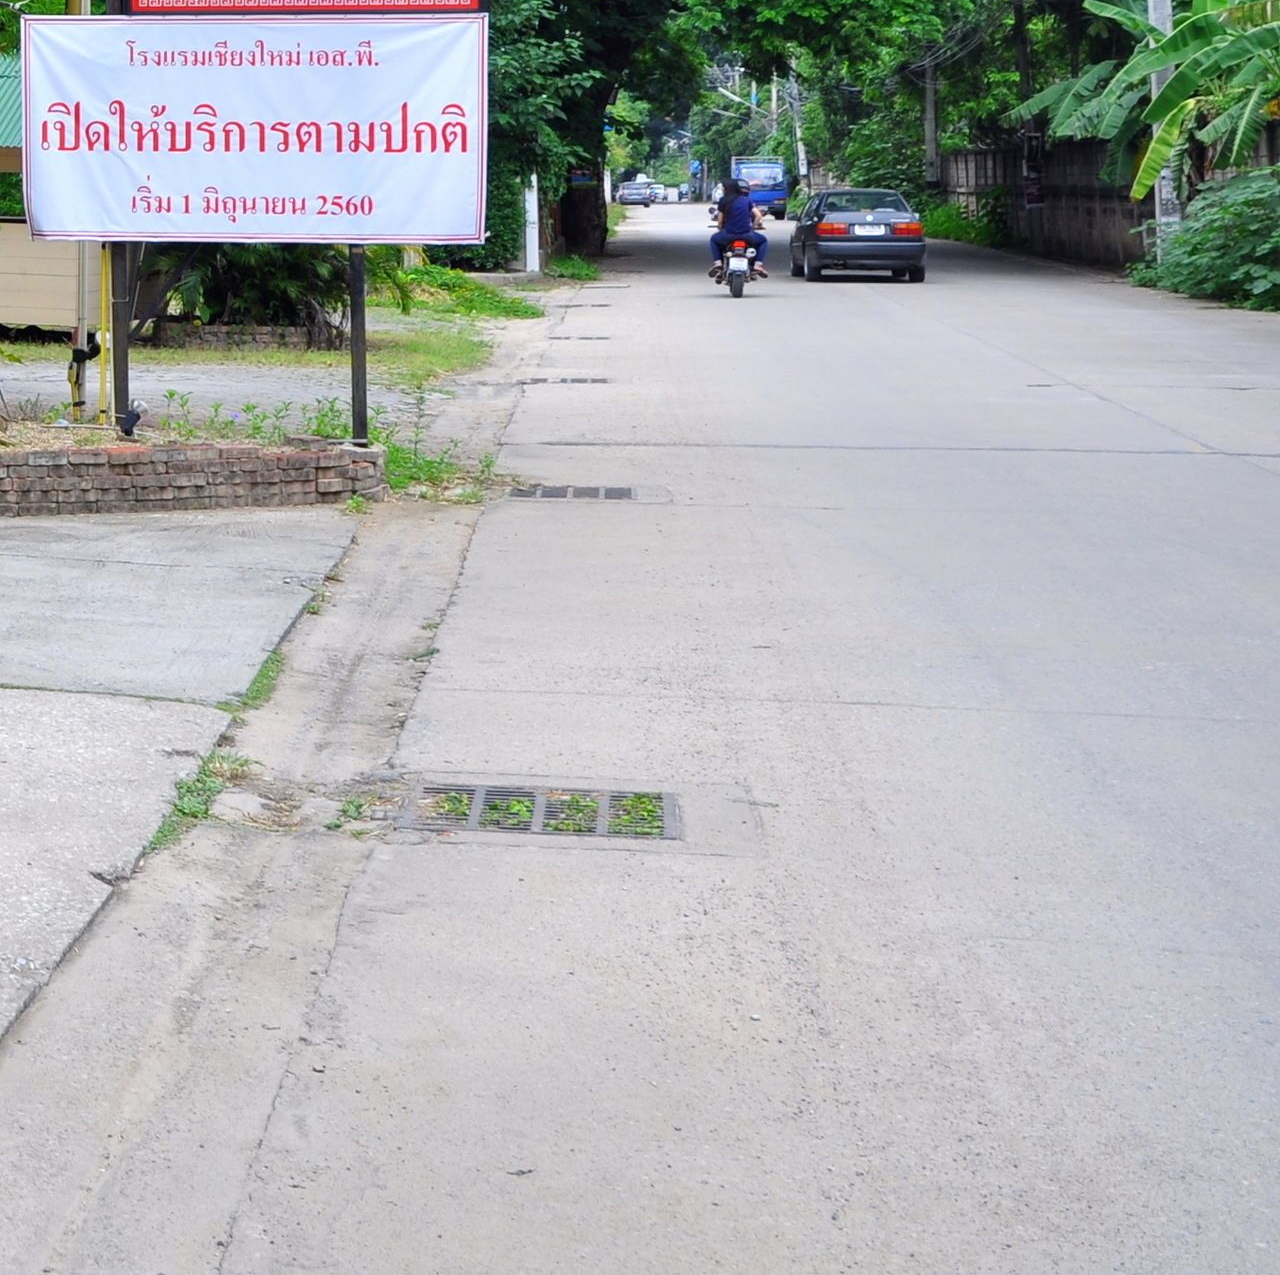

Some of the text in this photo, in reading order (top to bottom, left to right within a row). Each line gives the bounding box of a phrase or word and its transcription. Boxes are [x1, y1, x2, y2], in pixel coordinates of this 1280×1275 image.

[126, 39, 380, 67] โรงแรมเชียงใหม่ เอส.พี.
[40, 99, 469, 154] เปิดให้บริการตามปกติ
[131, 175, 374, 224] เริ่ม 1 มิถุนายน 2560
